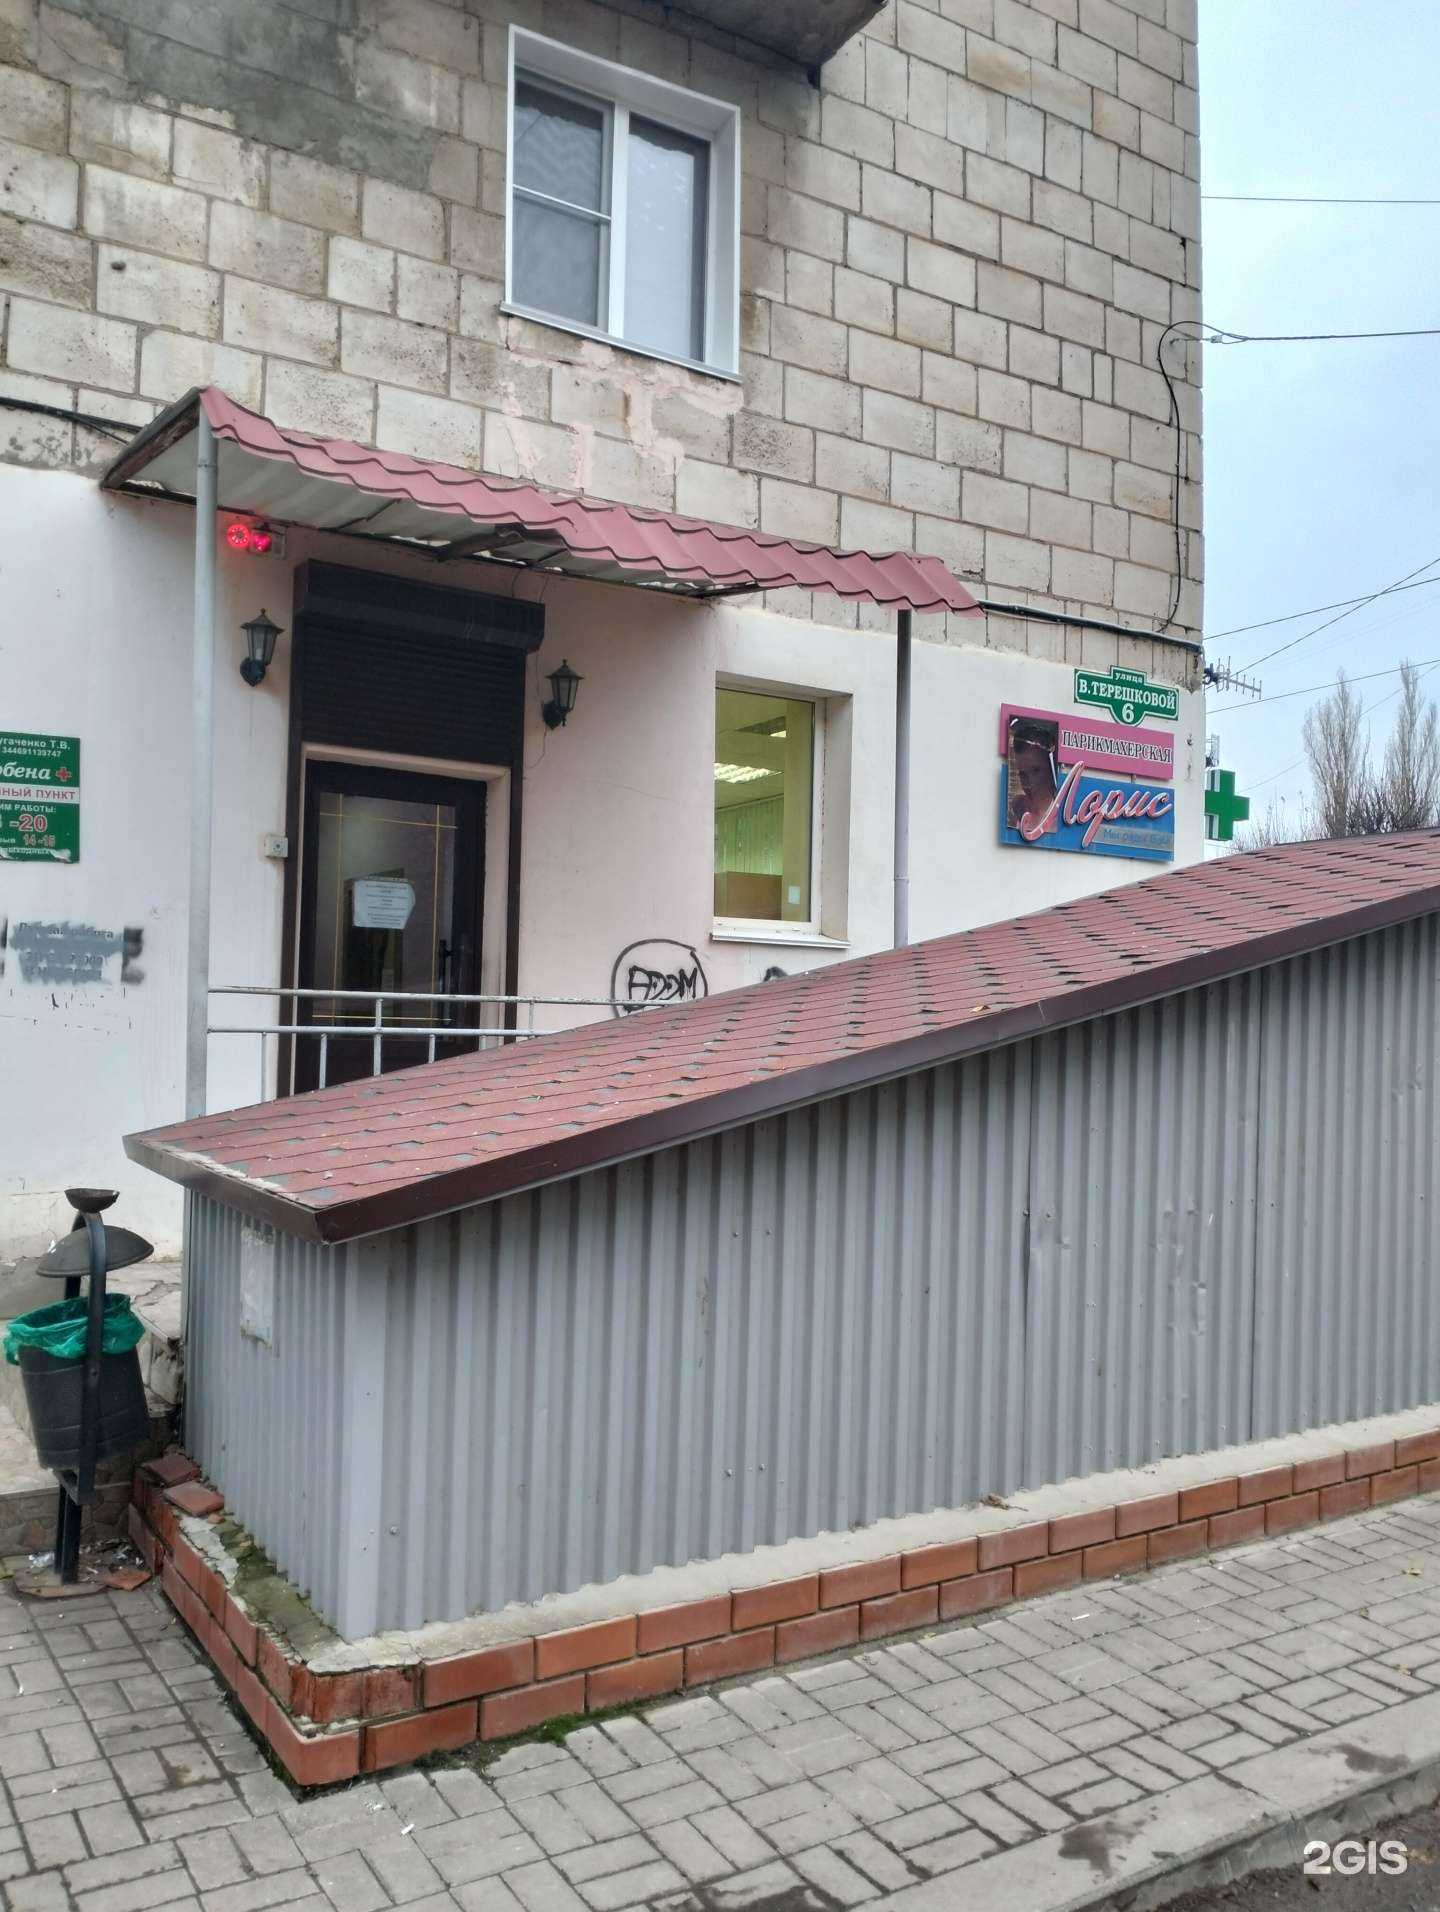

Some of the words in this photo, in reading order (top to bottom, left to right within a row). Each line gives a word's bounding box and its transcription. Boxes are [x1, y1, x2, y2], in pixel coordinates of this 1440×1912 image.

[1114, 671, 1143, 684] улица
[1078, 678, 1176, 710] В.ТЕРЕШКОВОЙ
[1121, 702, 1135, 723] 6
[1061, 729, 1173, 763] ПАРИКМАХЕРСКАЯ
[0, 786, 32, 798] ный
[36, 789, 76, 800] ПУНКТ
[14, 804, 57, 813] РАБОТЫ:
[1020, 760, 1173, 849] Лорис
